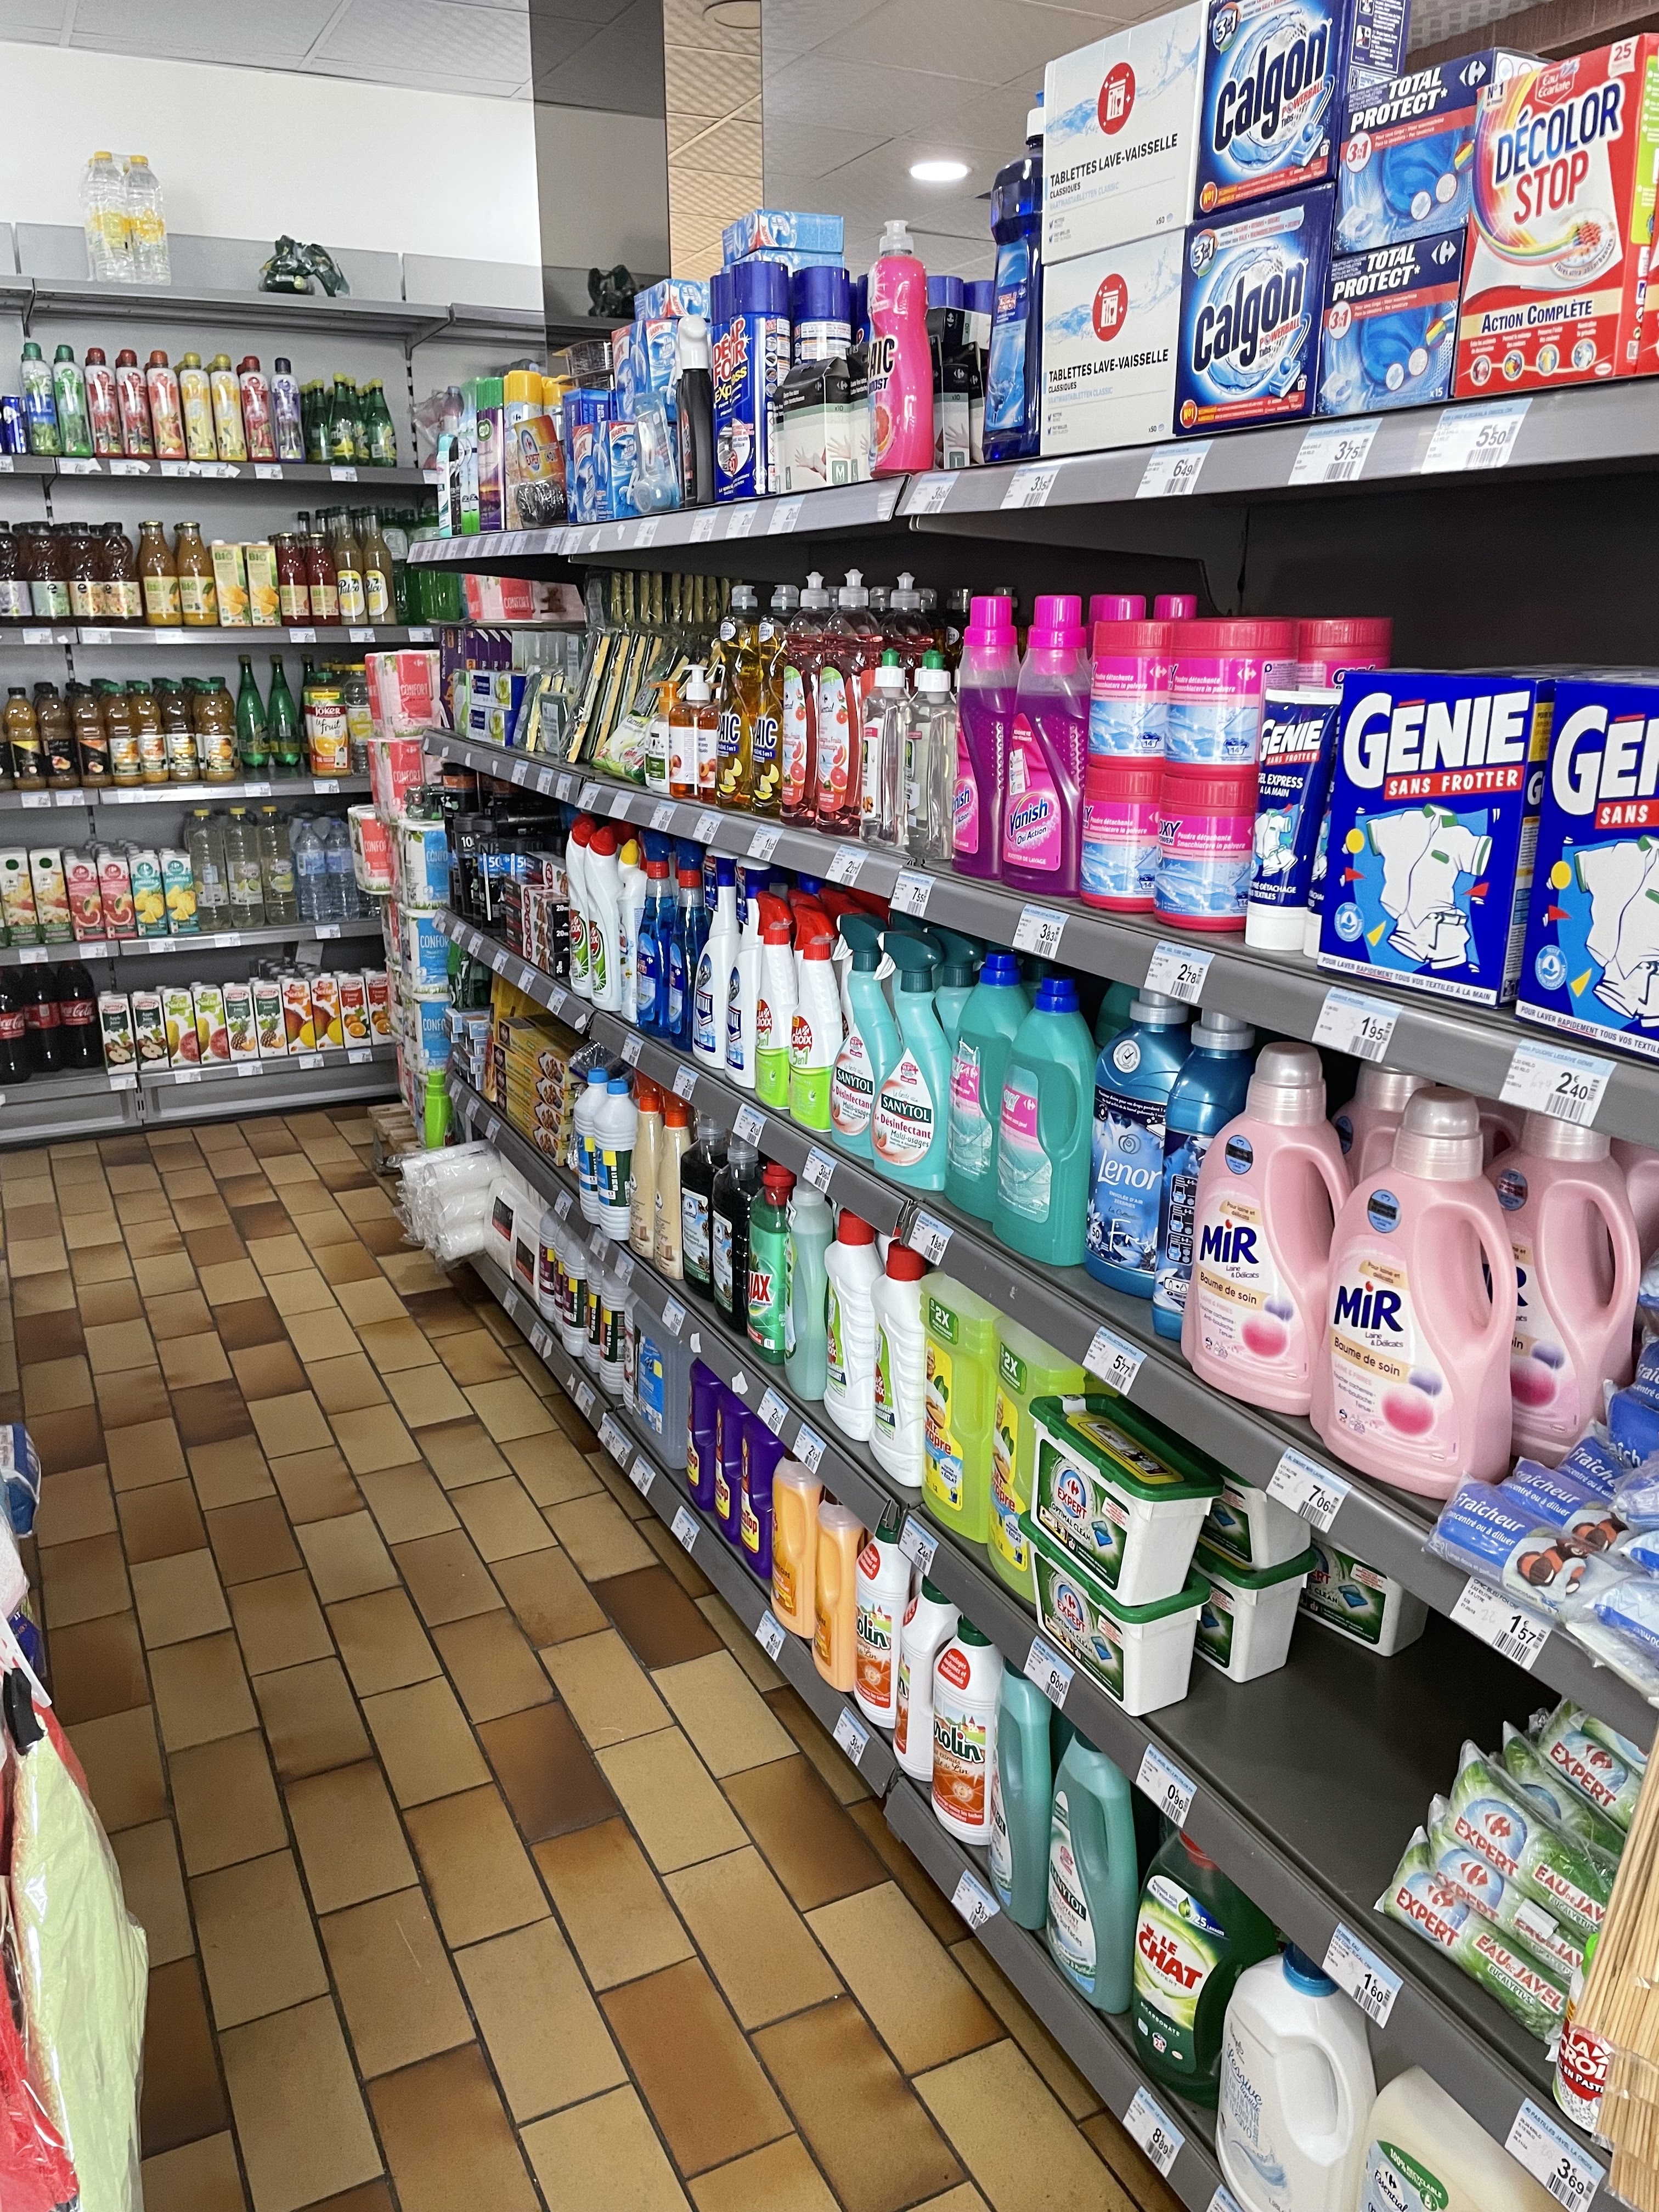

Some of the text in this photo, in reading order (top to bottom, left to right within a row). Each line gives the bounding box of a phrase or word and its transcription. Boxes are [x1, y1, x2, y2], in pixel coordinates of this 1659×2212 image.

[1614, 43, 1632, 60] 25
[1215, 23, 1326, 151] Calgon
[1389, 67, 1442, 100] TOTAL
[1496, 83, 1622, 183] DÉCOLOR
[1050, 133, 1178, 187] TABLETTES LAVE-VAISSELLE
[1050, 182, 1081, 199] CLASSIQUES
[1515, 150, 1589, 224] STOP
[1367, 244, 1416, 273] TOTAL
[1194, 262, 1304, 371] Calgon
[1481, 313, 1523, 334] ACTION
[1049, 348, 1169, 382] TABLETTES LAVE-VAISSELLE
[1048, 382, 1077, 393] CLASSIQUES
[1430, 389, 1443, 398] x15
[338, 579, 359, 595] Pulco
[400, 684, 428, 696] CONFORT
[1267, 753, 1317, 765] SANS FROTTER
[393, 770, 422, 783] CONFORT
[1267, 774, 1304, 789] EXPRESS
[1389, 771, 1518, 795] SANS FROTTER
[1264, 786, 1289, 797] LA MAIN
[1010, 798, 1048, 838] Vanish
[1601, 805, 1643, 823] SANS
[1018, 827, 1046, 845] Oxi Action
[1177, 840, 1215, 849] Smacchiatore
[1254, 890, 1276, 900] TEXTILES
[1323, 957, 1336, 966] POUR
[1337, 961, 1355, 970] LAVER
[1357, 964, 1393, 979] RAPIDEMENT
[1395, 974, 1410, 982] TOUS
[1412, 977, 1424, 985] VOS
[1426, 980, 1454, 992] TEXTILES
[1463, 987, 1471, 996] LA
[1472, 991, 1491, 1001] MAIN
[1521, 1006, 1632, 1045] POUR LAVER RAPIDEMENT TOUS VOS
[792, 1034, 812, 1045] CROIX
[837, 1071, 872, 1093] SANYTOL
[1555, 1071, 1588, 1099] 2€40
[883, 1096, 929, 1122] SANYTOL
[881, 1114, 931, 1139] Désinfectant
[891, 1130, 929, 1147] Multi-usages
[1098, 1149, 1163, 1190] Lenor
[1092, 1228, 1099, 1239] 50
[1200, 1272, 1223, 1291] Baume
[1225, 1285, 1235, 1296] de
[1238, 1293, 1257, 1305] soin
[935, 1306, 950, 1328] 2X
[1004, 1354, 1018, 1377] 2X
[1334, 1337, 1400, 1376] Baume de soin
[1058, 1487, 1087, 1519] EXPERT
[1455, 1492, 1526, 1532] Fraîcheur
[1531, 1493, 1571, 1517] ou à diluer
[1052, 1503, 1091, 1541] OPTIMAL CLEAN
[1476, 1525, 1516, 1547] ou à diluer
[1054, 1612, 1075, 1638] OPTIMAL
[1057, 1599, 1086, 1633] EXPERT
[1510, 1615, 1537, 1644] 1€57
[1550, 1742, 1617, 1808] EXPERT
[1454, 1816, 1519, 1876] EXPERT
[1535, 1864, 1568, 1896] EAU
[1194, 1915, 1224, 1937] 25 LAVAGES
[1396, 1887, 1460, 1948] EXPERT
[1160, 1936, 1178, 1956] LE
[1139, 1931, 1203, 1989] CHAT
[1476, 1934, 1510, 1966] EAU
[1514, 1967, 1563, 2012] JAVEL
[1489, 1965, 1534, 2006] EUCALYPTUS
[1141, 2001, 1181, 2036] BICARBONATE
[1568, 2030, 1590, 2058] LA
[1564, 2068, 1574, 2079] EN
[1531, 2112, 1555, 2136] PASTILLES
[1555, 2135, 1569, 2151] JAVEL
[1571, 2147, 1577, 2156] LA
[1390, 2148, 1407, 2172] 100%
[1557, 2158, 1584, 2194] 3€69
